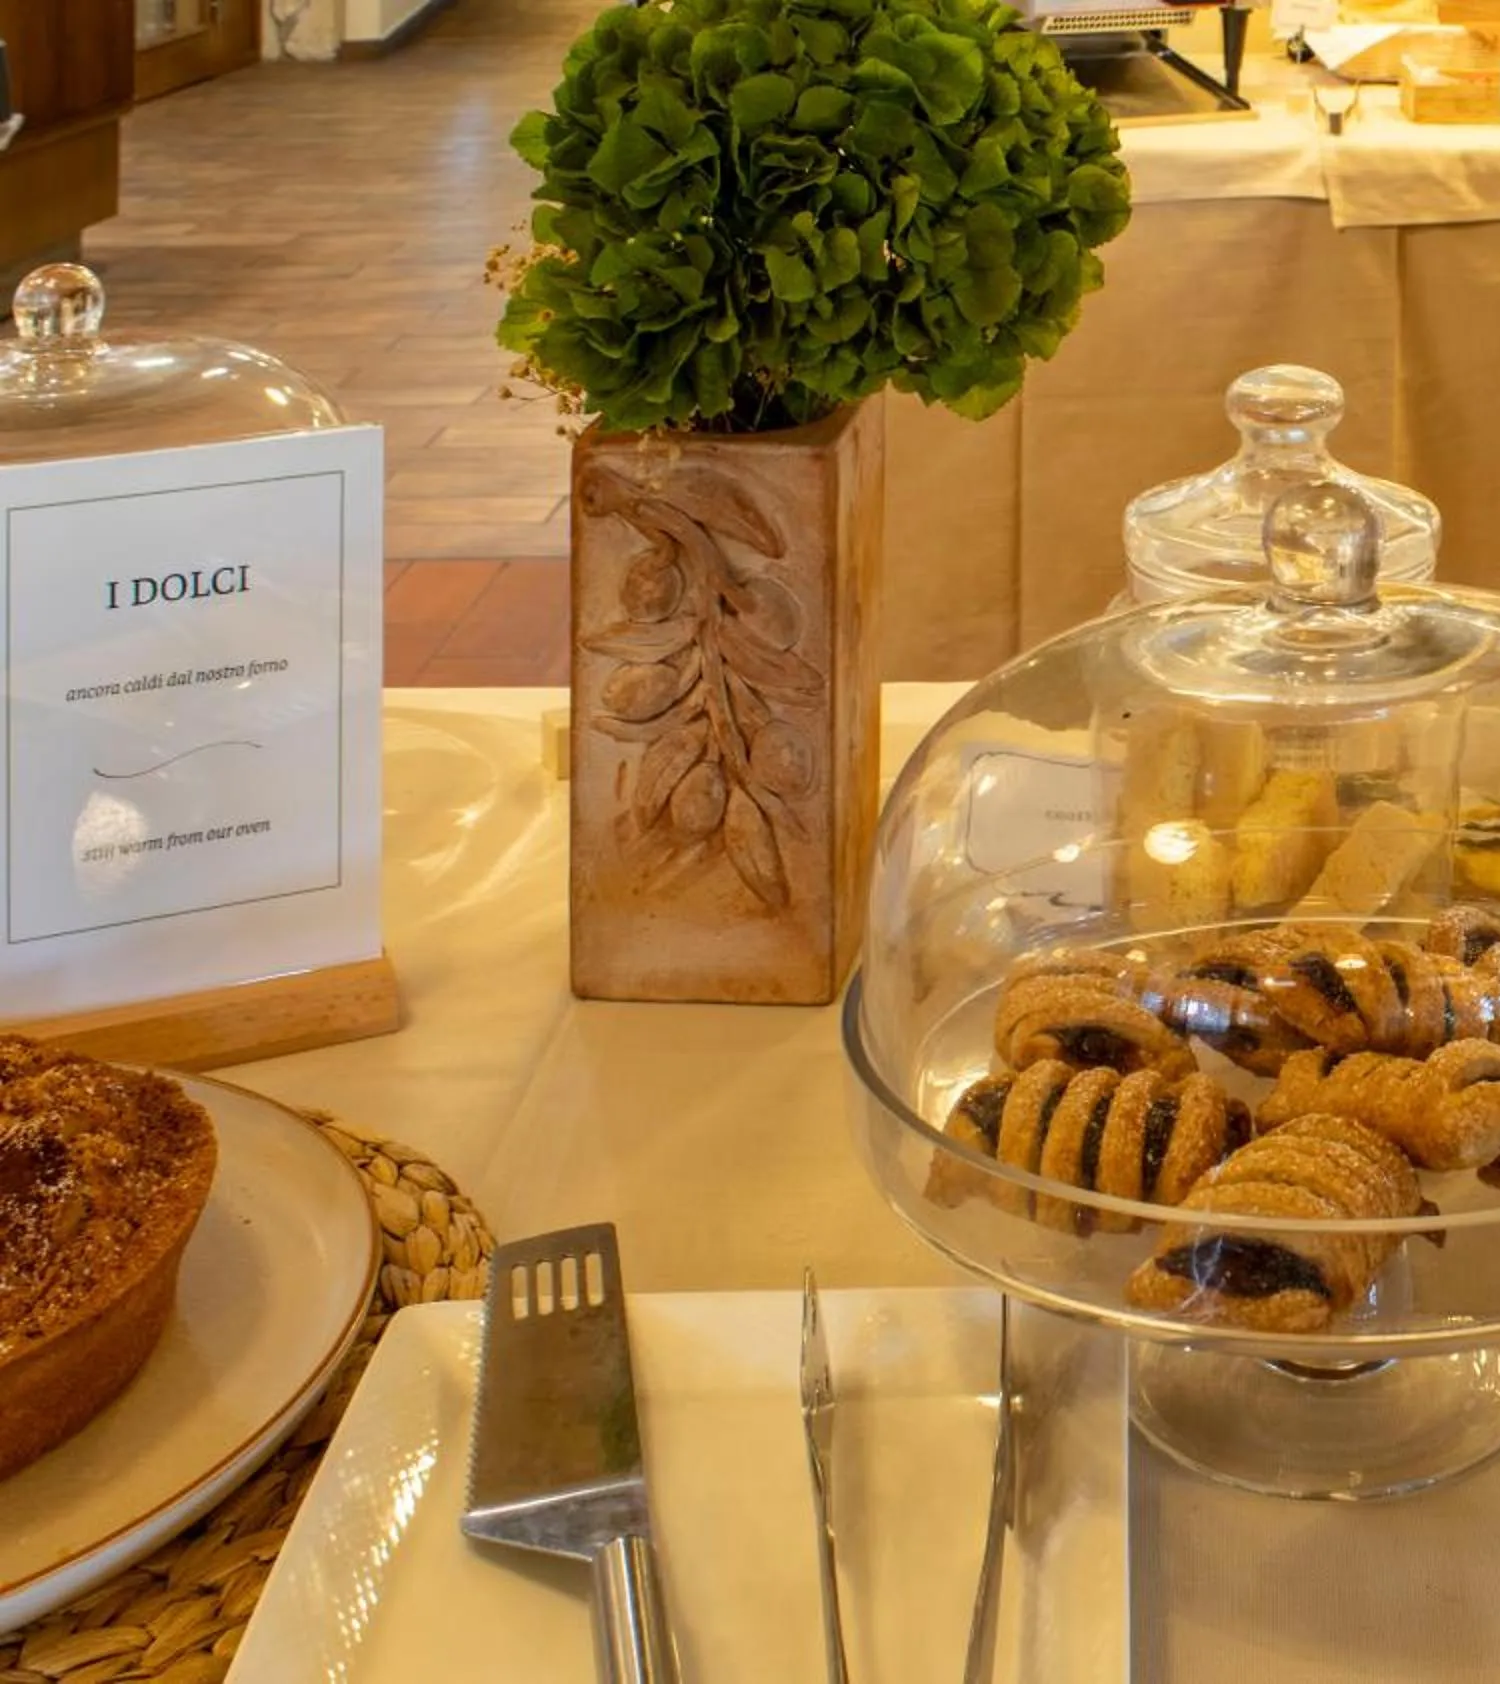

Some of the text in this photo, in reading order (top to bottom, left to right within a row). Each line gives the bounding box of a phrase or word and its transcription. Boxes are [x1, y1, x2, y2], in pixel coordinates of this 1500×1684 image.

[106, 565, 251, 610] I DOLCI
[66, 657, 289, 702] ancora caldi dal nostro forno
[118, 836, 163, 856] warm
[166, 831, 203, 851] from
[206, 825, 234, 841] our
[235, 819, 271, 836] oven
